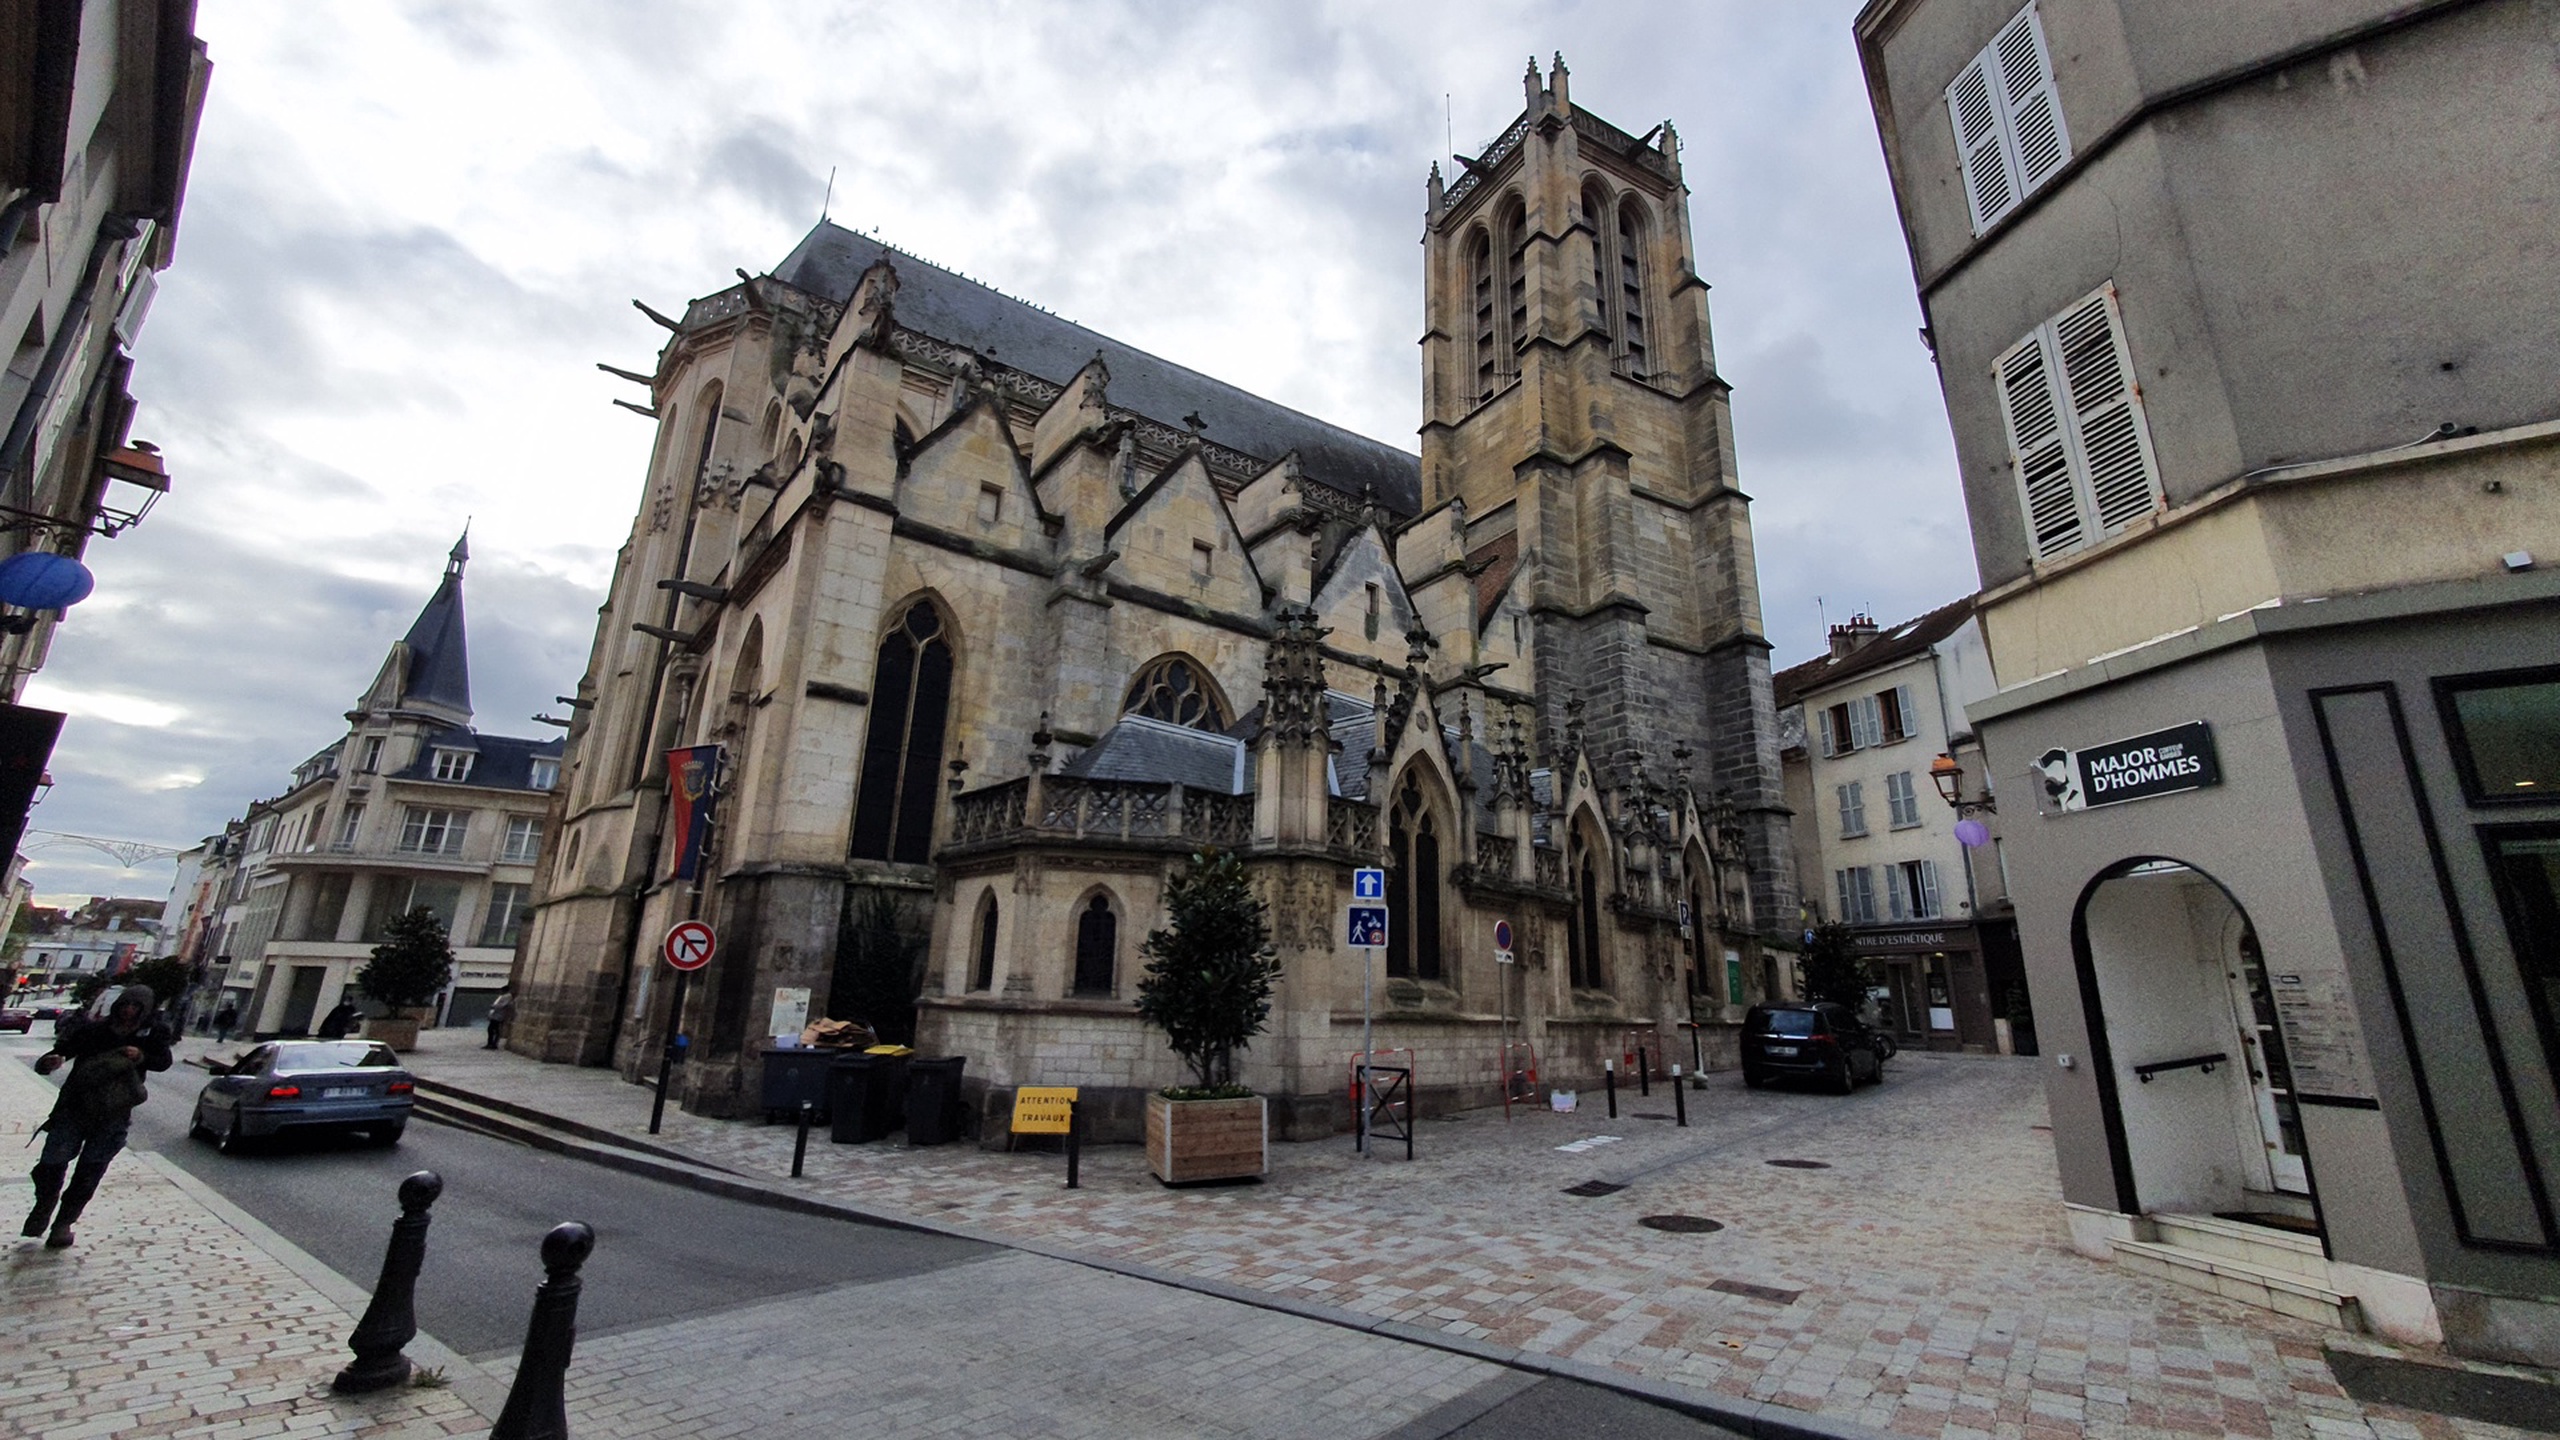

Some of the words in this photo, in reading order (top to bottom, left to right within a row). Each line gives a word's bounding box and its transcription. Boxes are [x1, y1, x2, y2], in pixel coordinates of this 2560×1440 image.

[2090, 747, 2158, 776] MAJOR
[2093, 755, 2201, 793] D'HOMMES
[1855, 936, 1877, 946] NTRE
[1879, 932, 1945, 945] D'ESTHÉTIQUE
[1020, 1096, 1073, 1105] ATTENTION
[1022, 1113, 1065, 1122] TRAVAUX
